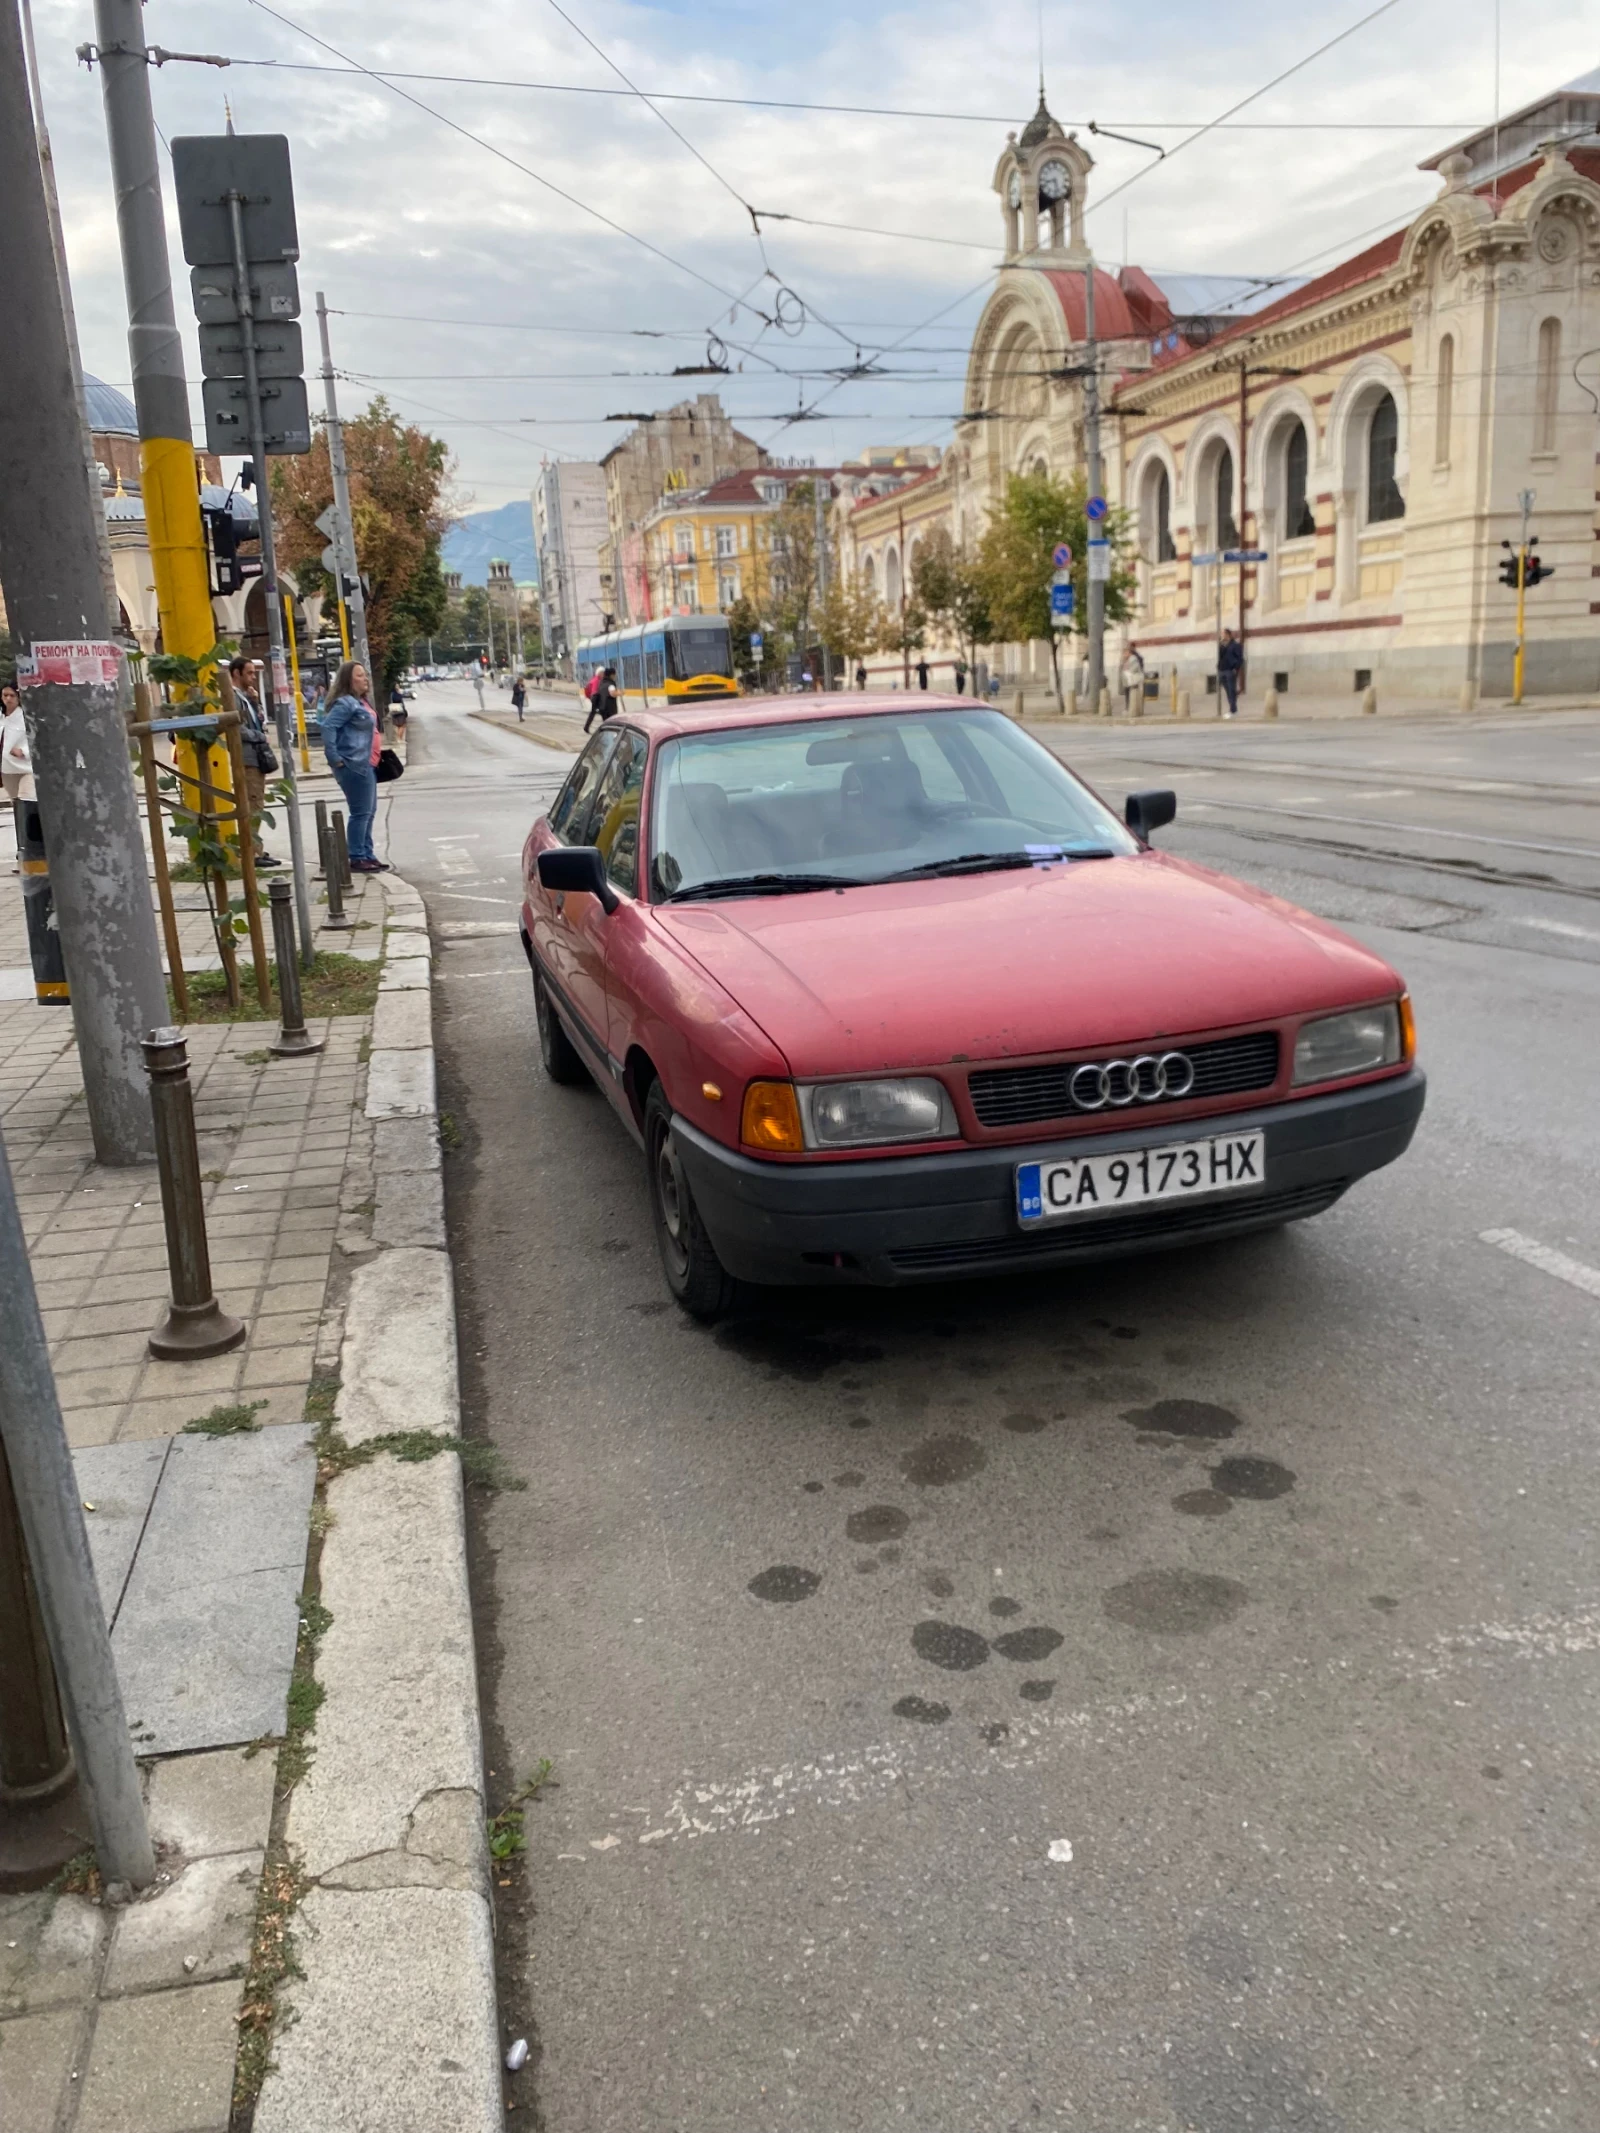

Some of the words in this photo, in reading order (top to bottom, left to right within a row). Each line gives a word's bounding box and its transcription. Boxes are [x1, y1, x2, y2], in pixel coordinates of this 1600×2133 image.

[35, 645, 74, 658] РЕМОНТ
[76, 645, 90, 657] НА
[1047, 1164, 1099, 1206] CA
[1108, 1150, 1201, 1198] 9173
[1210, 1139, 1257, 1183] HX
[1022, 1197, 1040, 1211] BG
